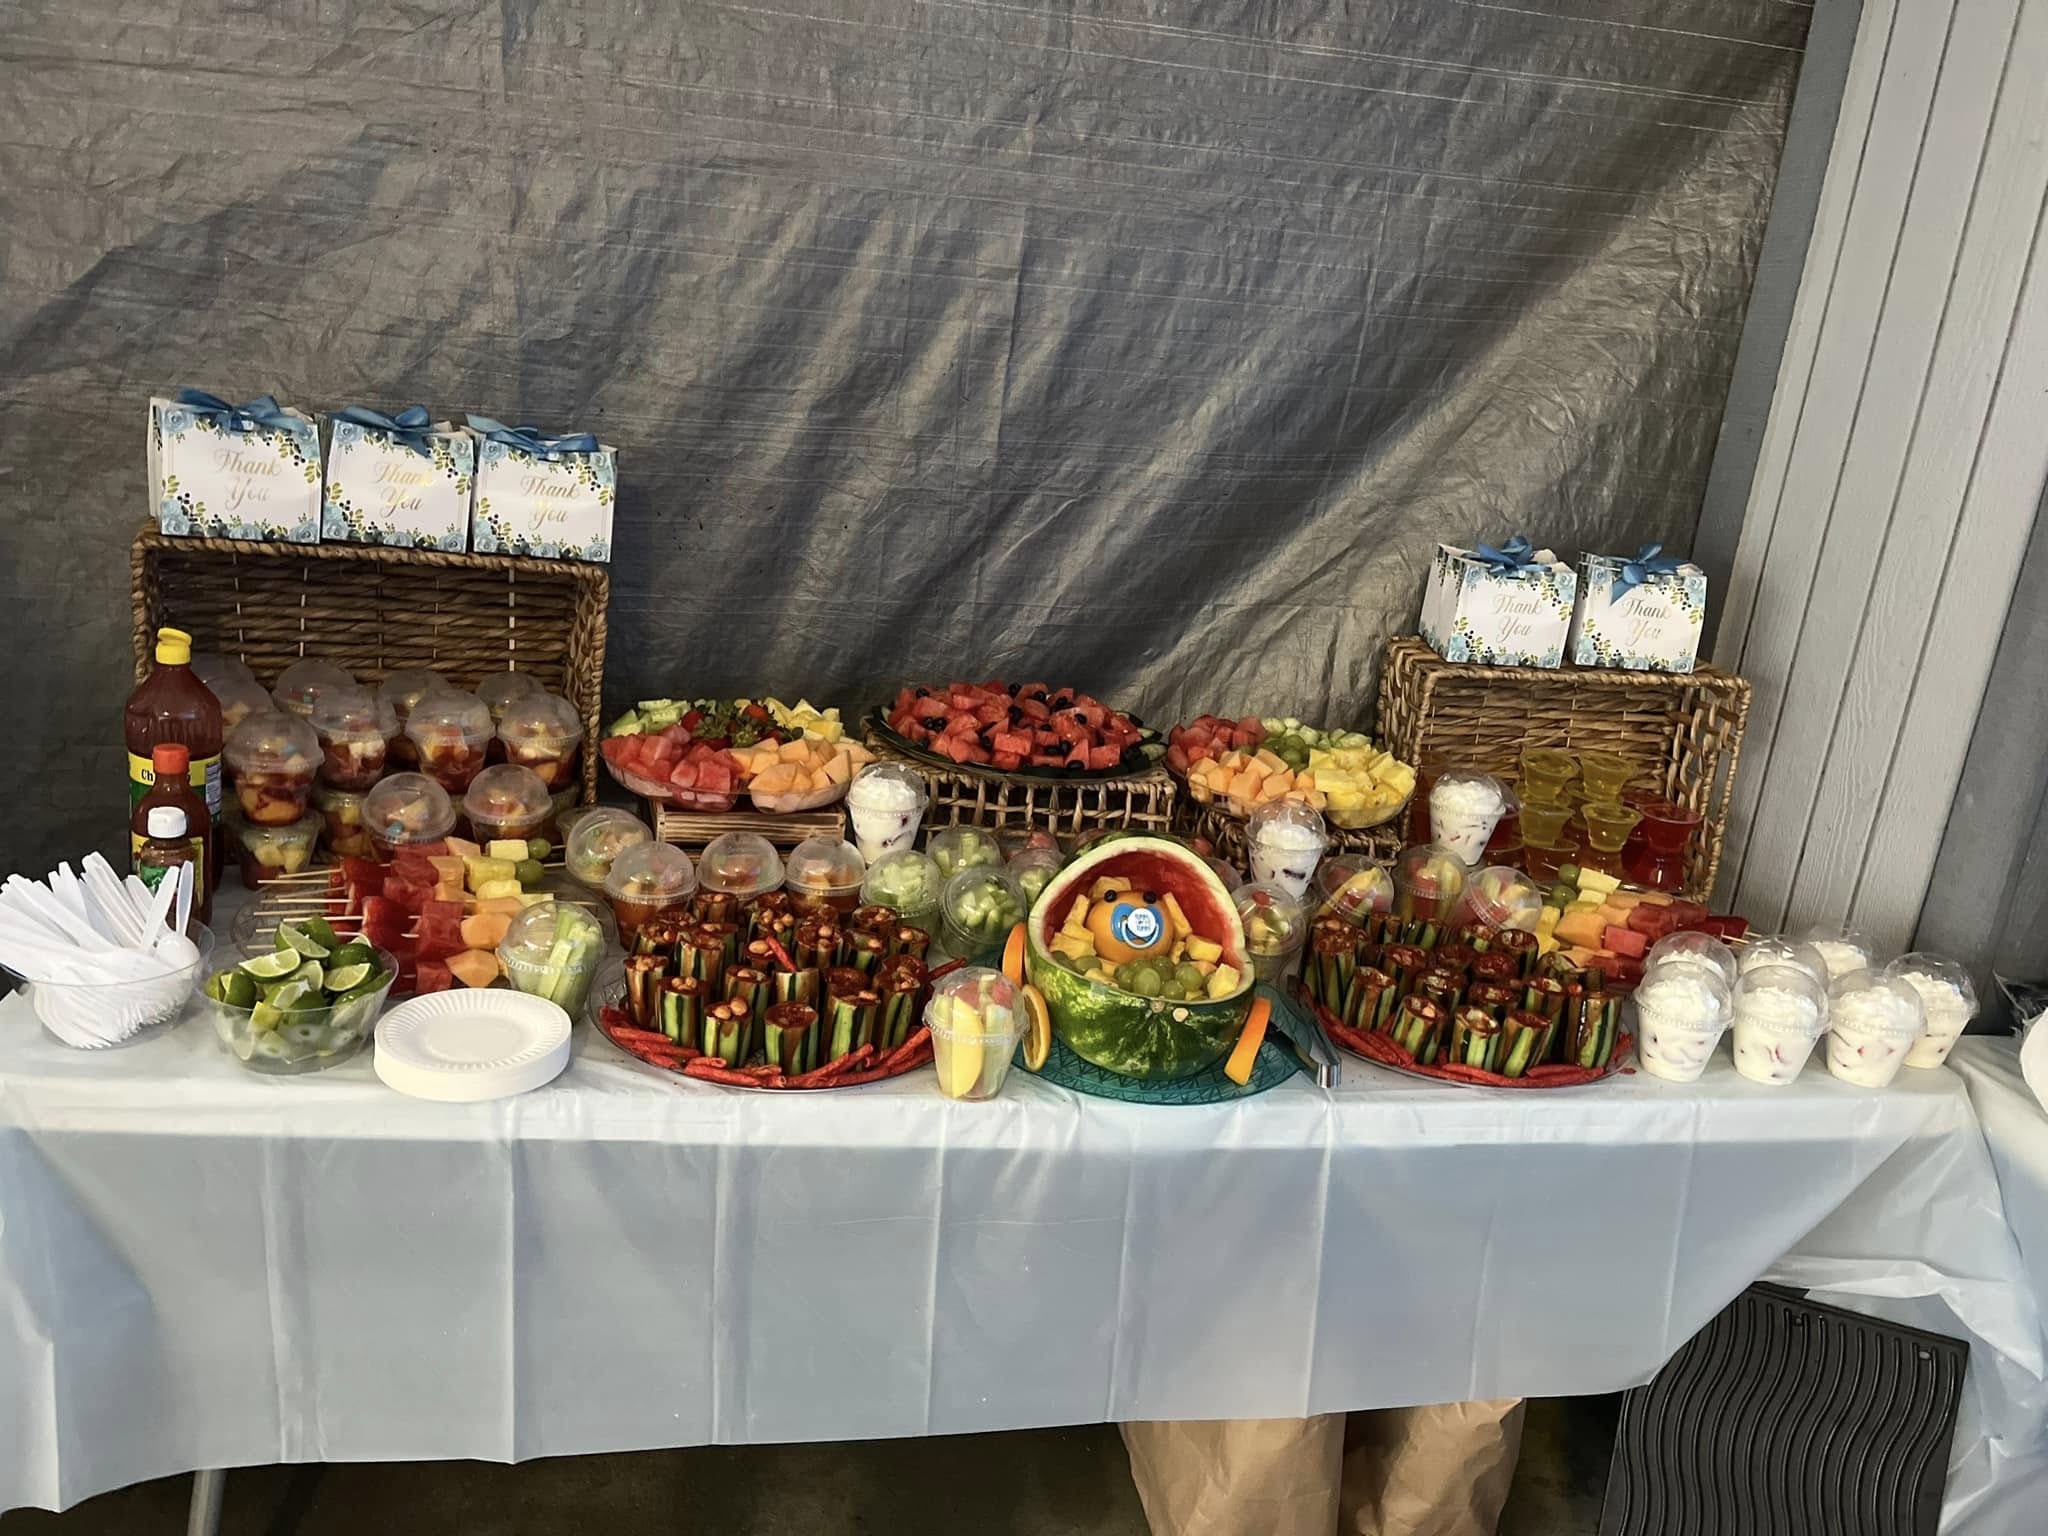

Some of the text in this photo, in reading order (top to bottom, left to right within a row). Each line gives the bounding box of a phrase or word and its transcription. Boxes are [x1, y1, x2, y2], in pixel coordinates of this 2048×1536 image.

[214, 450, 281, 476] Thank
[373, 460, 434, 487] Thank
[225, 478, 271, 511] You
[520, 474, 579, 499] Thank
[379, 484, 423, 518] You
[529, 501, 568, 530] You
[1491, 594, 1544, 616] Thank
[1620, 597, 1673, 619] Thank
[1497, 616, 1532, 643] You
[1625, 619, 1661, 647] You
